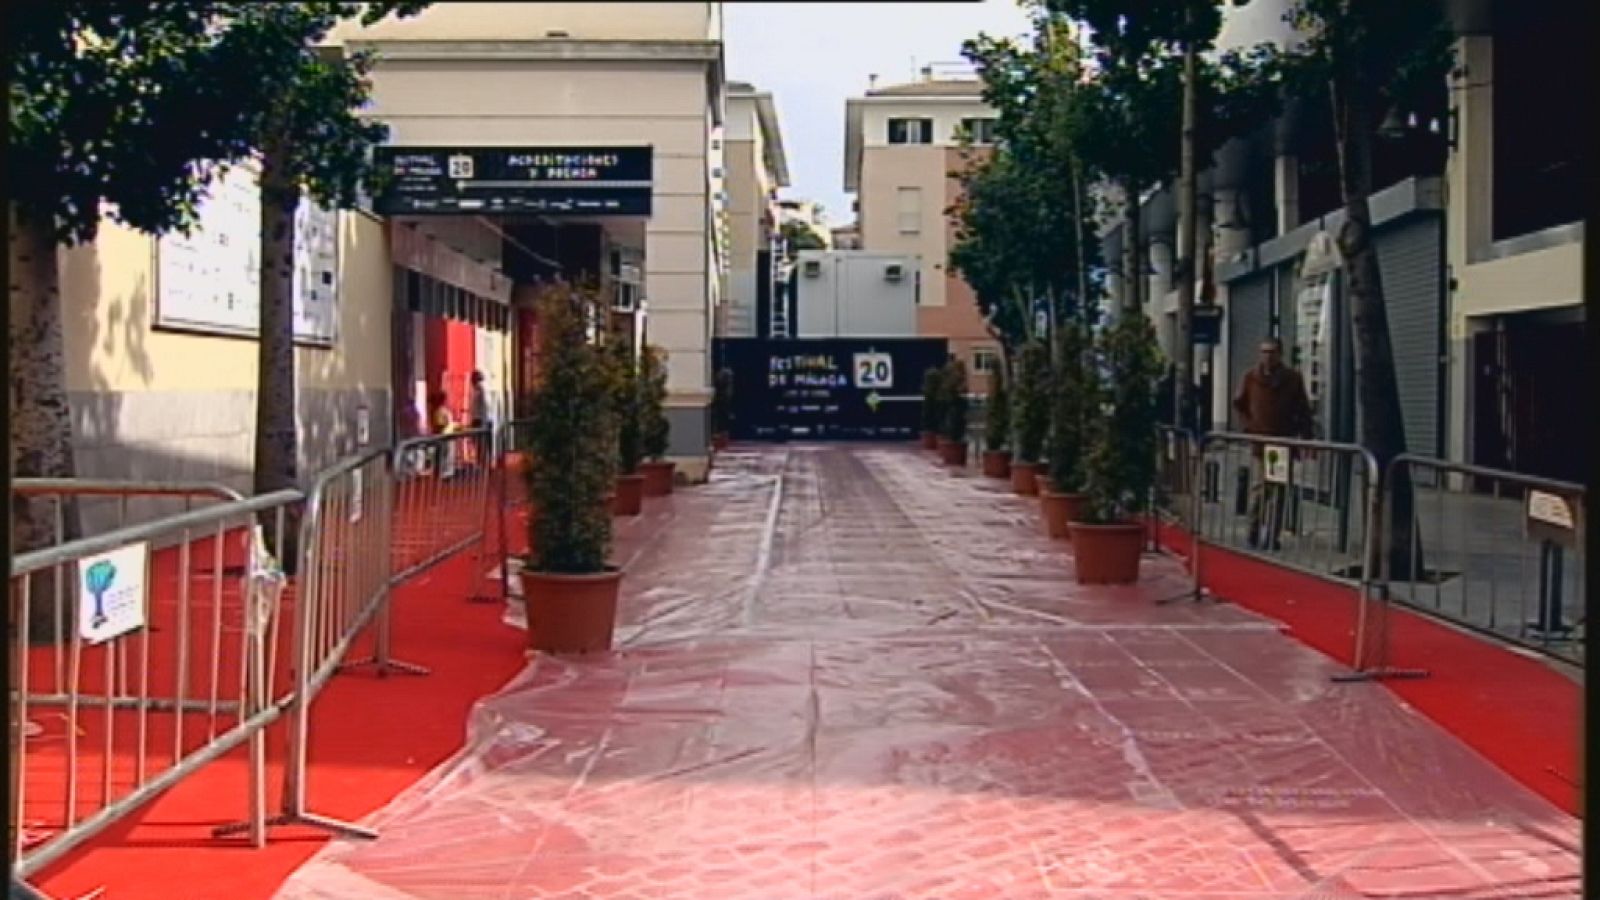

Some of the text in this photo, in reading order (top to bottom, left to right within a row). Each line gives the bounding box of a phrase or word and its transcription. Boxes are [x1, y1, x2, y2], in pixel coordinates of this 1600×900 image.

[769, 355, 838, 370] FESTIVAL
[859, 360, 891, 384] 20
[768, 374, 787, 387] DE
